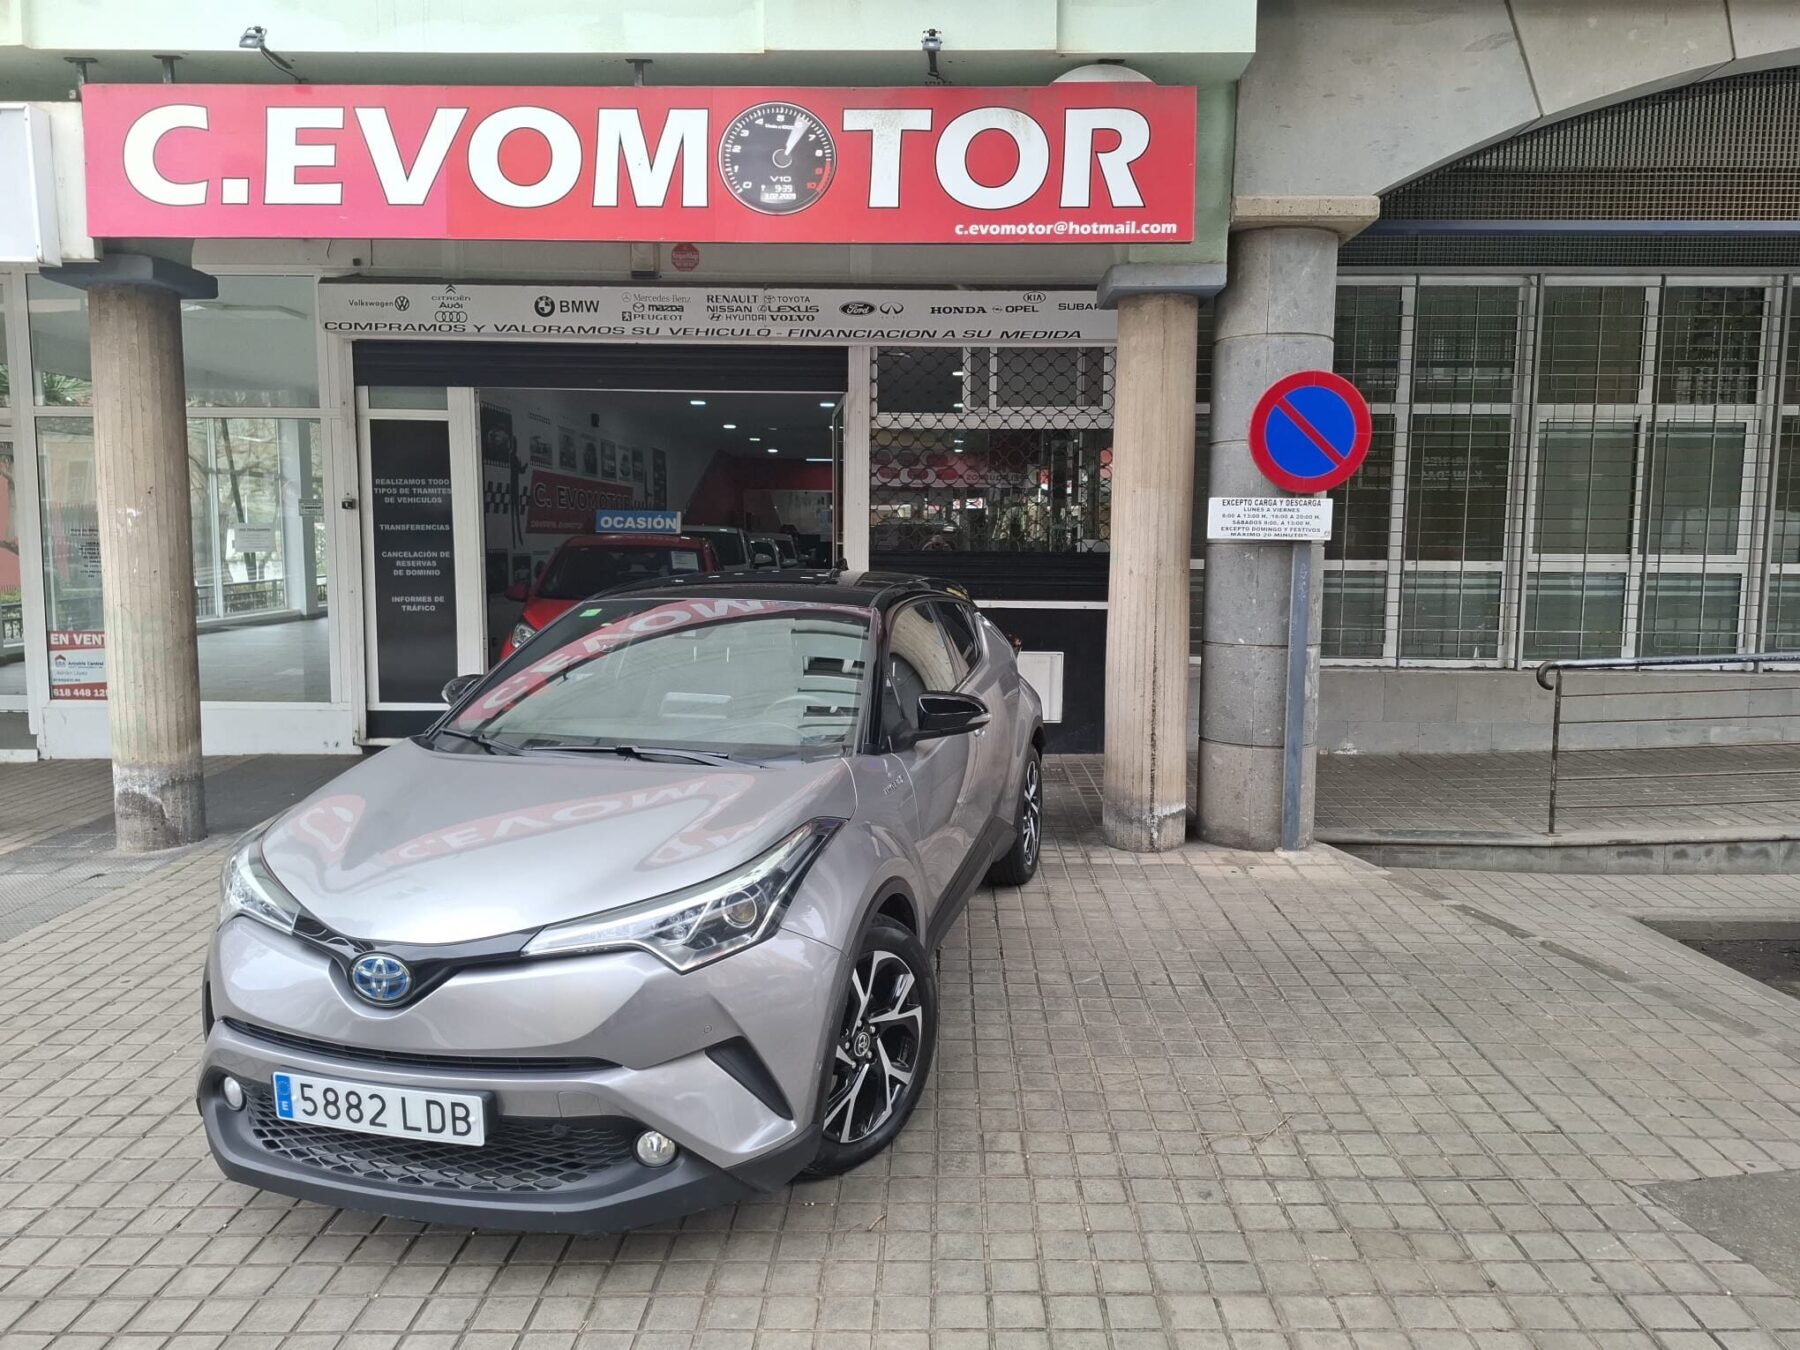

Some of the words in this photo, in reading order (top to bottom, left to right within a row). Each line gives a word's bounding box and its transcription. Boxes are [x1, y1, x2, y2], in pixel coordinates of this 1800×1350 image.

[954, 220, 1178, 238] c.evomotor@hotmail.com
[633, 293, 692, 303] Mercedes-Benz
[706, 295, 758, 304] RENAULT
[349, 299, 394, 307] Volkswagen
[560, 300, 599, 313] BMW
[768, 305, 819, 313] LEXUS
[847, 303, 870, 313] Ford
[930, 306, 987, 314] HONDA
[1005, 305, 1039, 313] OPEL
[633, 313, 683, 321] PEUGEOT
[324, 321, 466, 332] COMPRAMOS
[473, 324, 486, 333] Y
[494, 323, 625, 335] VALORAMOS
[632, 327, 660, 335] SU
[669, 327, 771, 337] VEHICULO
[788, 328, 937, 338] FINANCIACION
[942, 329, 956, 338] A
[962, 329, 993, 338] SU
[1000, 330, 1081, 339] MEDIDA
[1222, 499, 1252, 507] EXCEPTO
[1254, 499, 1277, 507] CARGA
[601, 515, 677, 529] OCASIÓN
[381, 550, 438, 558] CANCELACIÓN
[50, 633, 69, 645] EN
[73, 688, 92, 696] 448
[281, 1101, 289, 1111] E
[299, 1082, 388, 1128] 5882
[400, 1096, 472, 1137] LDB
